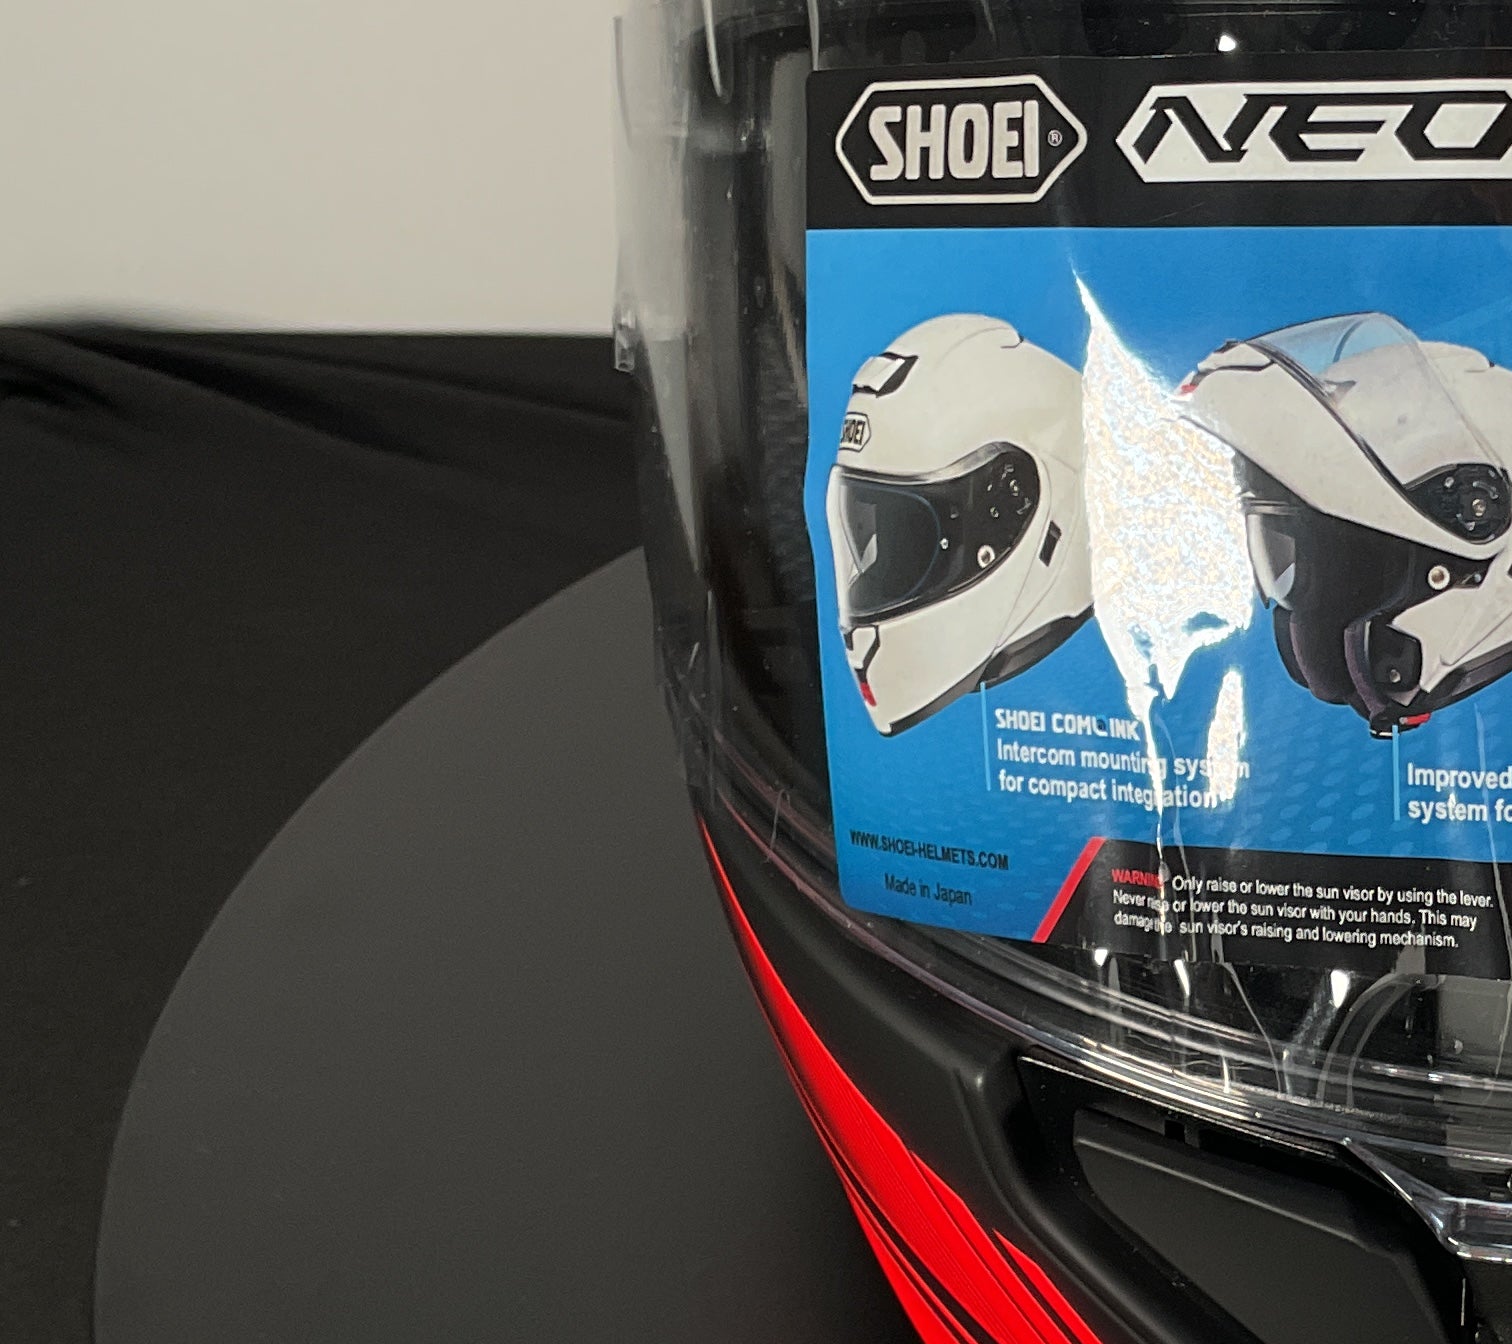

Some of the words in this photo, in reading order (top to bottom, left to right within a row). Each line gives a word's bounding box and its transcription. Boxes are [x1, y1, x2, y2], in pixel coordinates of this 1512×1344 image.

[995, 708, 1046, 733] SHOEI
[997, 738, 1076, 767] Intercom
[999, 769, 1025, 793] for
[1028, 777, 1107, 804] compact
[1111, 782, 1217, 811] integation
[1407, 762, 1512, 793] Improved
[1408, 794, 1488, 825] system
[849, 829, 1009, 870] WWW.SHOEI-HELMETS.COM
[884, 873, 917, 898] Made
[919, 879, 931, 899] in
[934, 883, 973, 906] Japan
[1172, 875, 1204, 895] Only
[1206, 877, 1237, 893] raise
[1240, 881, 1253, 894] or
[1256, 879, 1290, 897] lower
[1293, 882, 1313, 897] the
[1316, 887, 1340, 900] sun
[1343, 885, 1375, 902] visor
[1377, 886, 1394, 905] by
[1397, 887, 1434, 906] using
[1436, 889, 1457, 905] the
[1460, 890, 1494, 908] lever.
[1113, 889, 1146, 906] Never
[1173, 899, 1188, 913] or
[1190, 898, 1224, 913] lower
[1227, 899, 1248, 915] the
[1251, 903, 1274, 916] sun
[1277, 902, 1306, 918] visor
[1310, 906, 1336, 921] with
[1339, 910, 1368, 925] your
[1370, 907, 1416, 925] hands.
[1418, 909, 1447, 926] This
[1451, 914, 1477, 932] may
[1179, 920, 1204, 935] sun
[1207, 919, 1249, 937] visor's
[1251, 922, 1292, 942] raising
[1295, 926, 1319, 941] and
[1322, 926, 1377, 948] lowering
[1379, 930, 1459, 948] mechanism.
